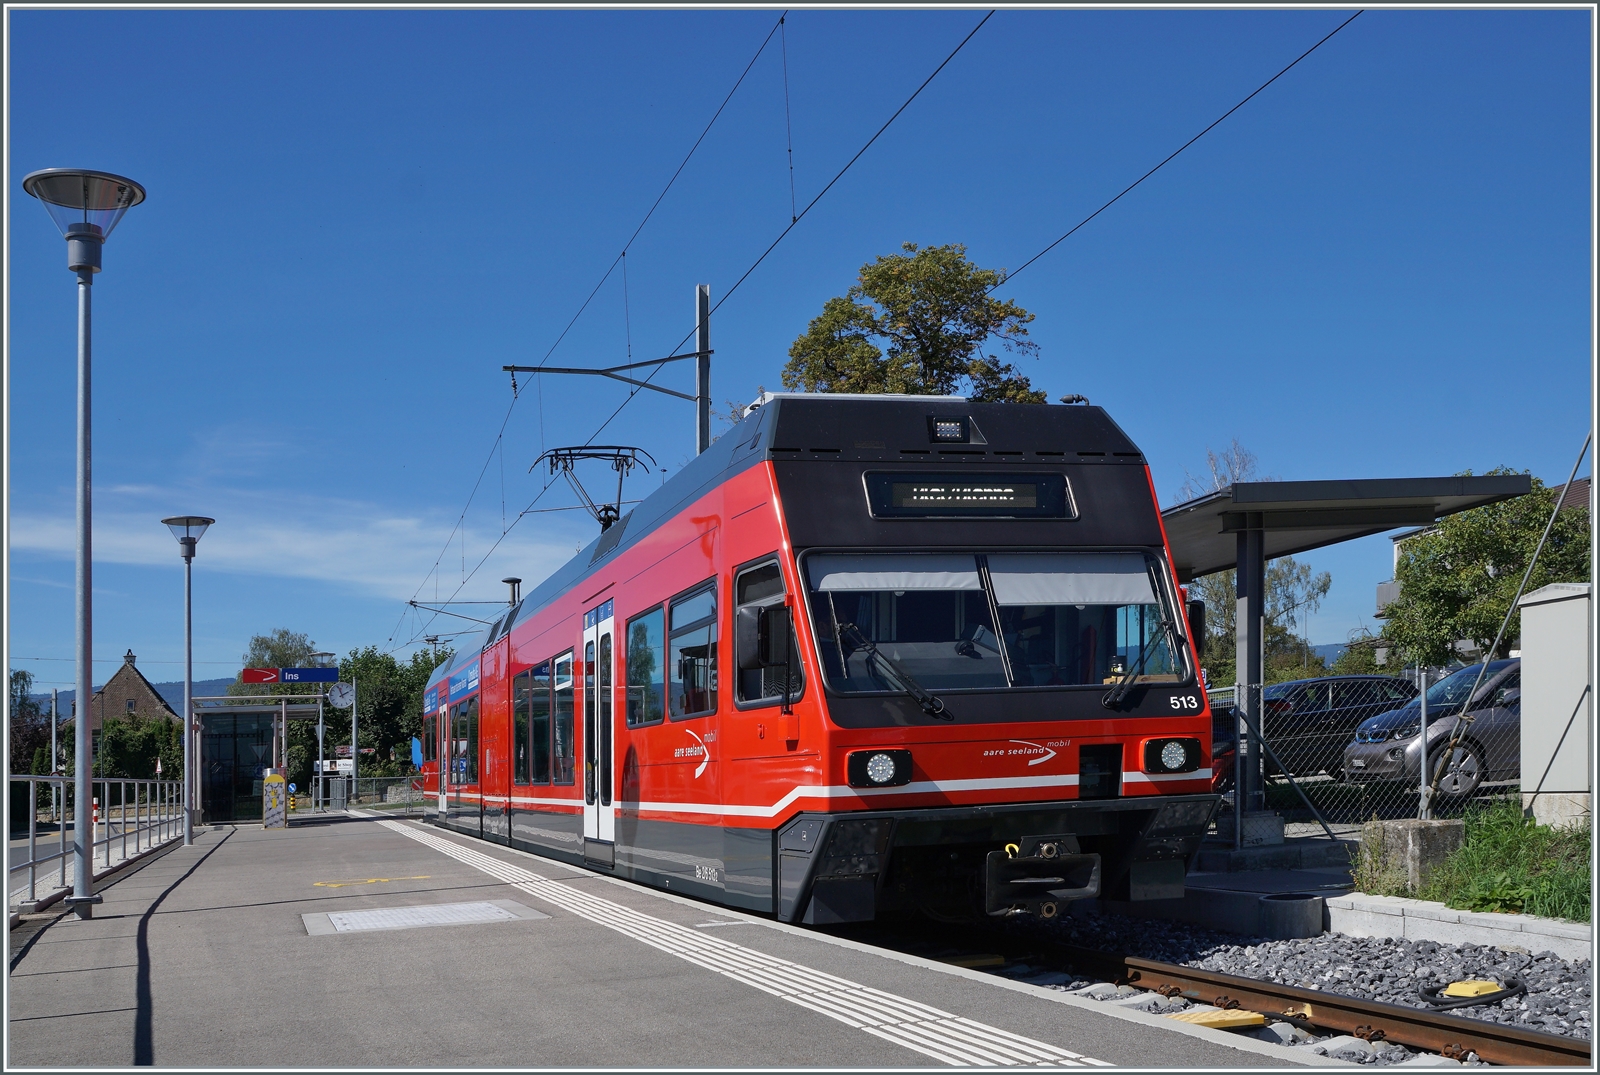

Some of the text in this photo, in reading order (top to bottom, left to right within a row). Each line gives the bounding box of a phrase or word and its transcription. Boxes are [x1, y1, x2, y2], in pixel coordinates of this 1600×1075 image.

[285, 672, 299, 680] Ins
[1170, 696, 1198, 709] 513
[704, 730, 717, 742] mobil
[674, 743, 704, 757] aare seeland
[1007, 746, 1045, 756] seeland
